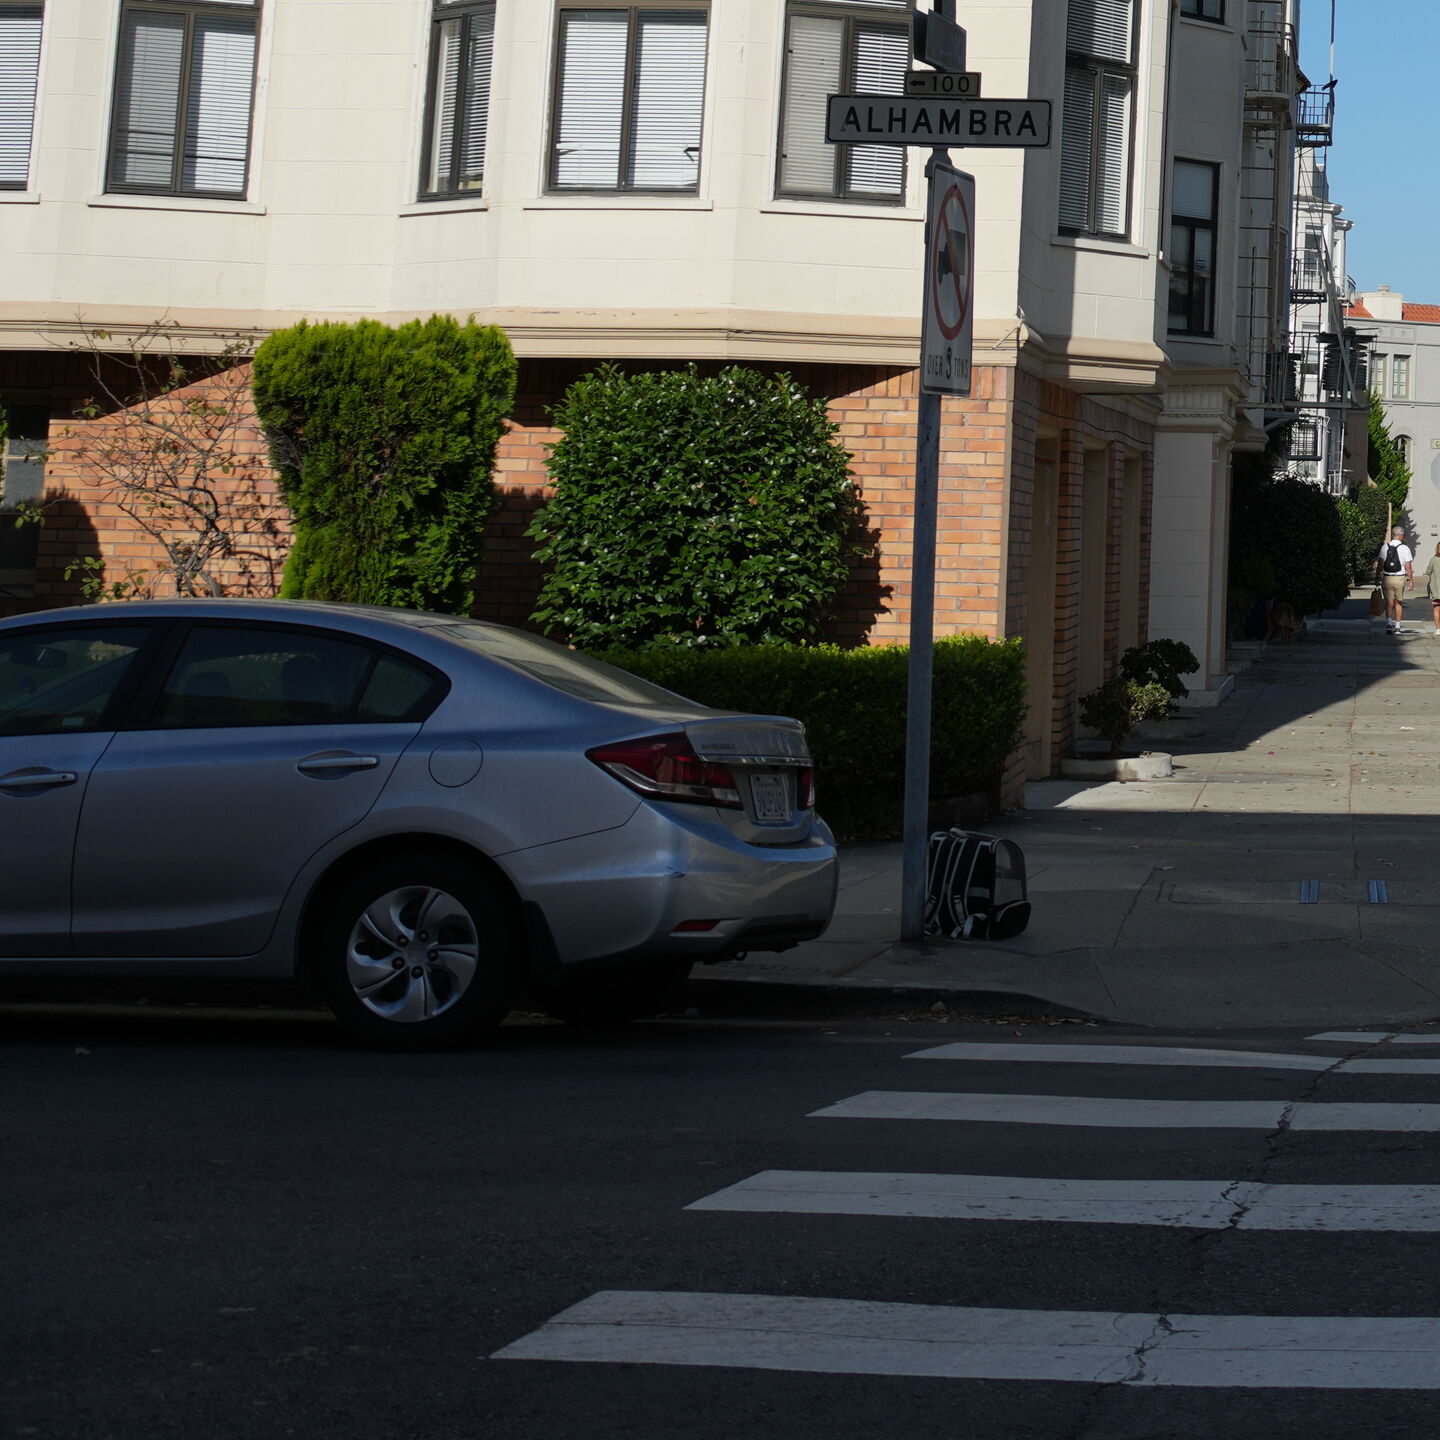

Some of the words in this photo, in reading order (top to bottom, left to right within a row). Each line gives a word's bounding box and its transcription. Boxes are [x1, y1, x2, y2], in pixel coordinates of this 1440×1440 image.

[930, 75, 970, 93] 100
[840, 106, 1038, 137] ALHAMBRA
[927, 353, 943, 377] OVER
[954, 356, 969, 379] TONS
